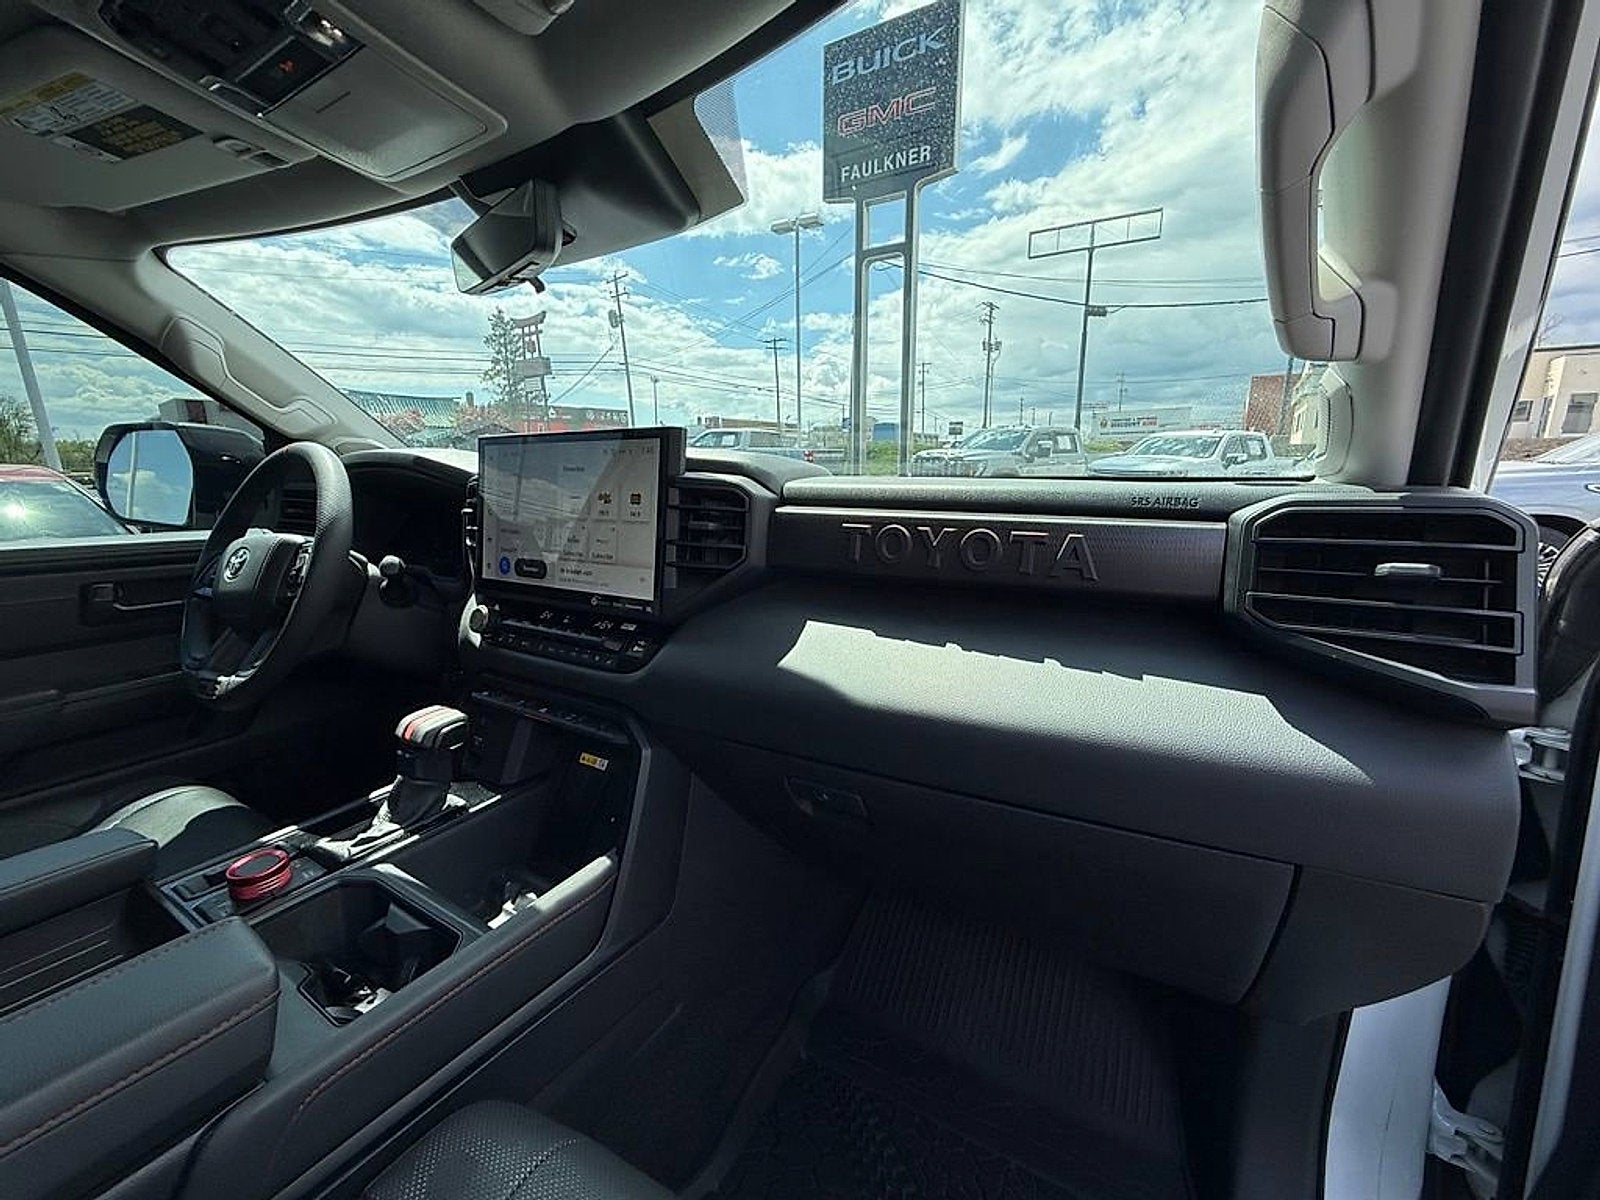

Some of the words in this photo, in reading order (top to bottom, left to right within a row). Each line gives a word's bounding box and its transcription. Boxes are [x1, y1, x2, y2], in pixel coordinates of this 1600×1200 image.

[832, 25, 946, 85] BUICK
[837, 86, 936, 135] GMC
[841, 145, 931, 182] FAULKNER
[1131, 496, 1151, 507] SRS
[1153, 496, 1199, 508] AIRBAG
[841, 523, 1099, 581] TOYOTA
